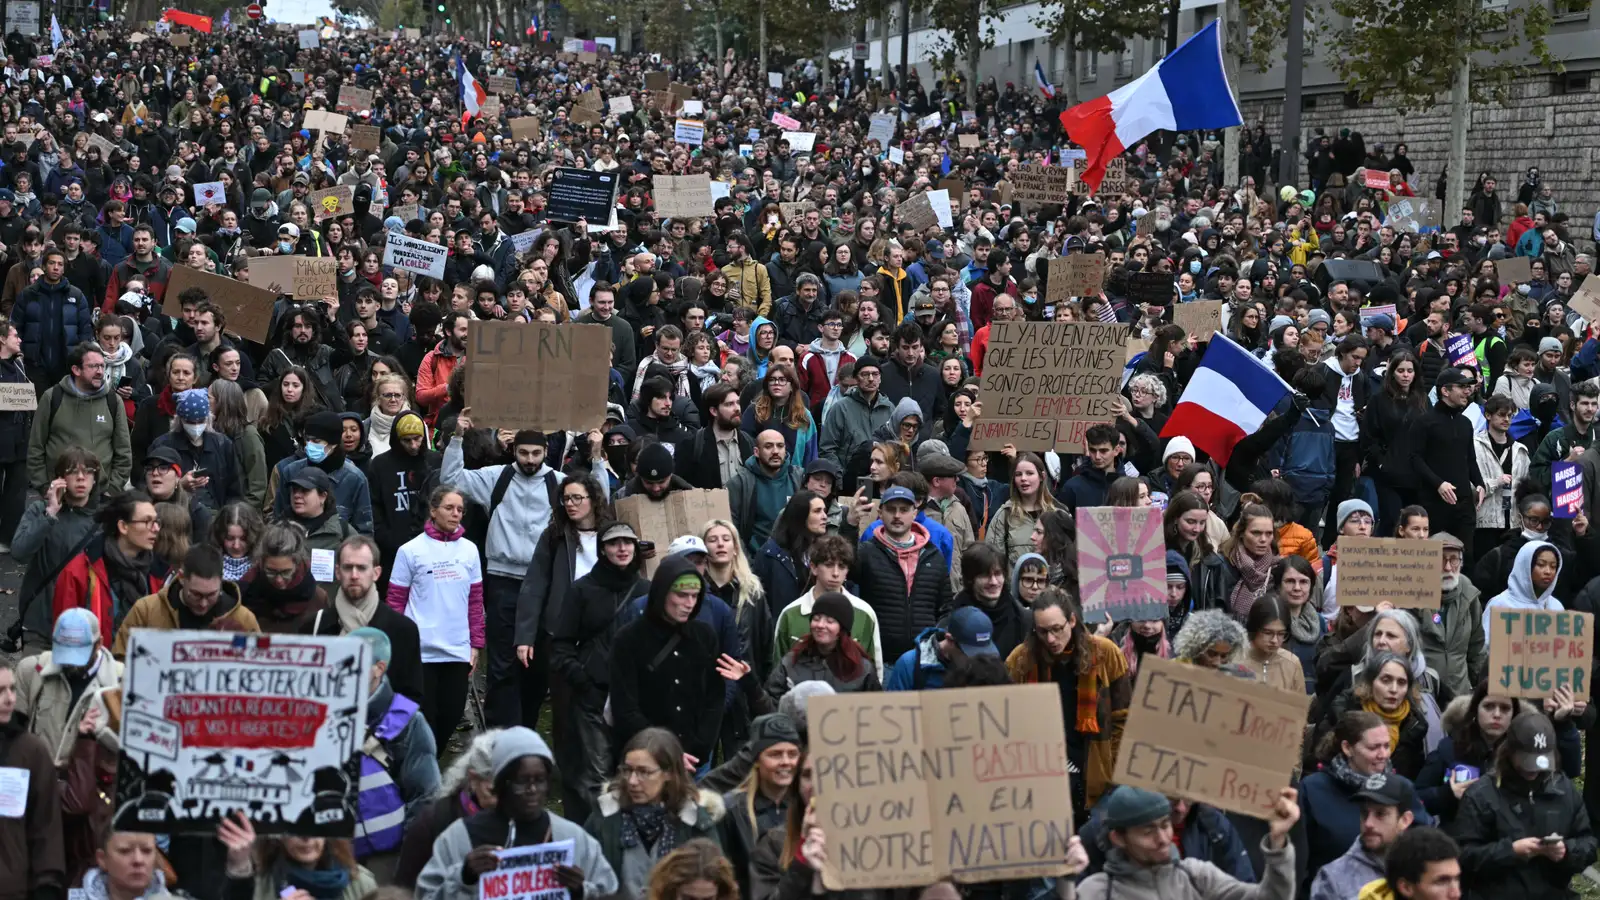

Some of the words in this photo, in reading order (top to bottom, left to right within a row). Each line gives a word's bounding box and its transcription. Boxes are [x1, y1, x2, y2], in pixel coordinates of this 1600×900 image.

[394, 256, 404, 266] LA
[538, 327, 573, 361] RN
[990, 323, 1012, 344] IL
[1086, 324, 1129, 348] FRANCE
[1448, 336, 1468, 354] BAISSE
[988, 348, 1017, 368] QUE
[1022, 348, 1046, 370] LES
[1053, 348, 1116, 370] VITRINES
[1458, 344, 1470, 355] DES
[984, 373, 1024, 392] SONT
[1038, 372, 1104, 395] PROTÉGÉES
[998, 398, 1024, 416] LES
[1086, 400, 1108, 416] LES
[1025, 420, 1051, 440] LES
[396, 471, 407, 490] I
[1555, 466, 1576, 482] BAISSE
[1566, 476, 1576, 490] DES
[1500, 612, 1584, 636] TIRER
[1553, 637, 1584, 659] PAS
[159, 665, 210, 694] MERCI
[216, 668, 236, 692] DE
[238, 669, 297, 696] RESTER
[1500, 666, 1584, 693] JUGER
[165, 696, 228, 718] PENDANT
[228, 697, 244, 716] LA
[1142, 672, 1222, 724] ETAT
[184, 720, 200, 736] DE
[204, 719, 229, 736] VOS
[819, 706, 922, 746] C'EST
[950, 698, 1010, 742] EN
[816, 747, 964, 794] PRENANT
[973, 741, 1066, 780] BASTILLE
[1126, 742, 1208, 791] ETAT
[946, 793, 964, 816] A
[990, 787, 1033, 812] EU
[840, 830, 933, 872] NOTRE
[949, 819, 1070, 866] NATION
[484, 874, 508, 899] NOS
